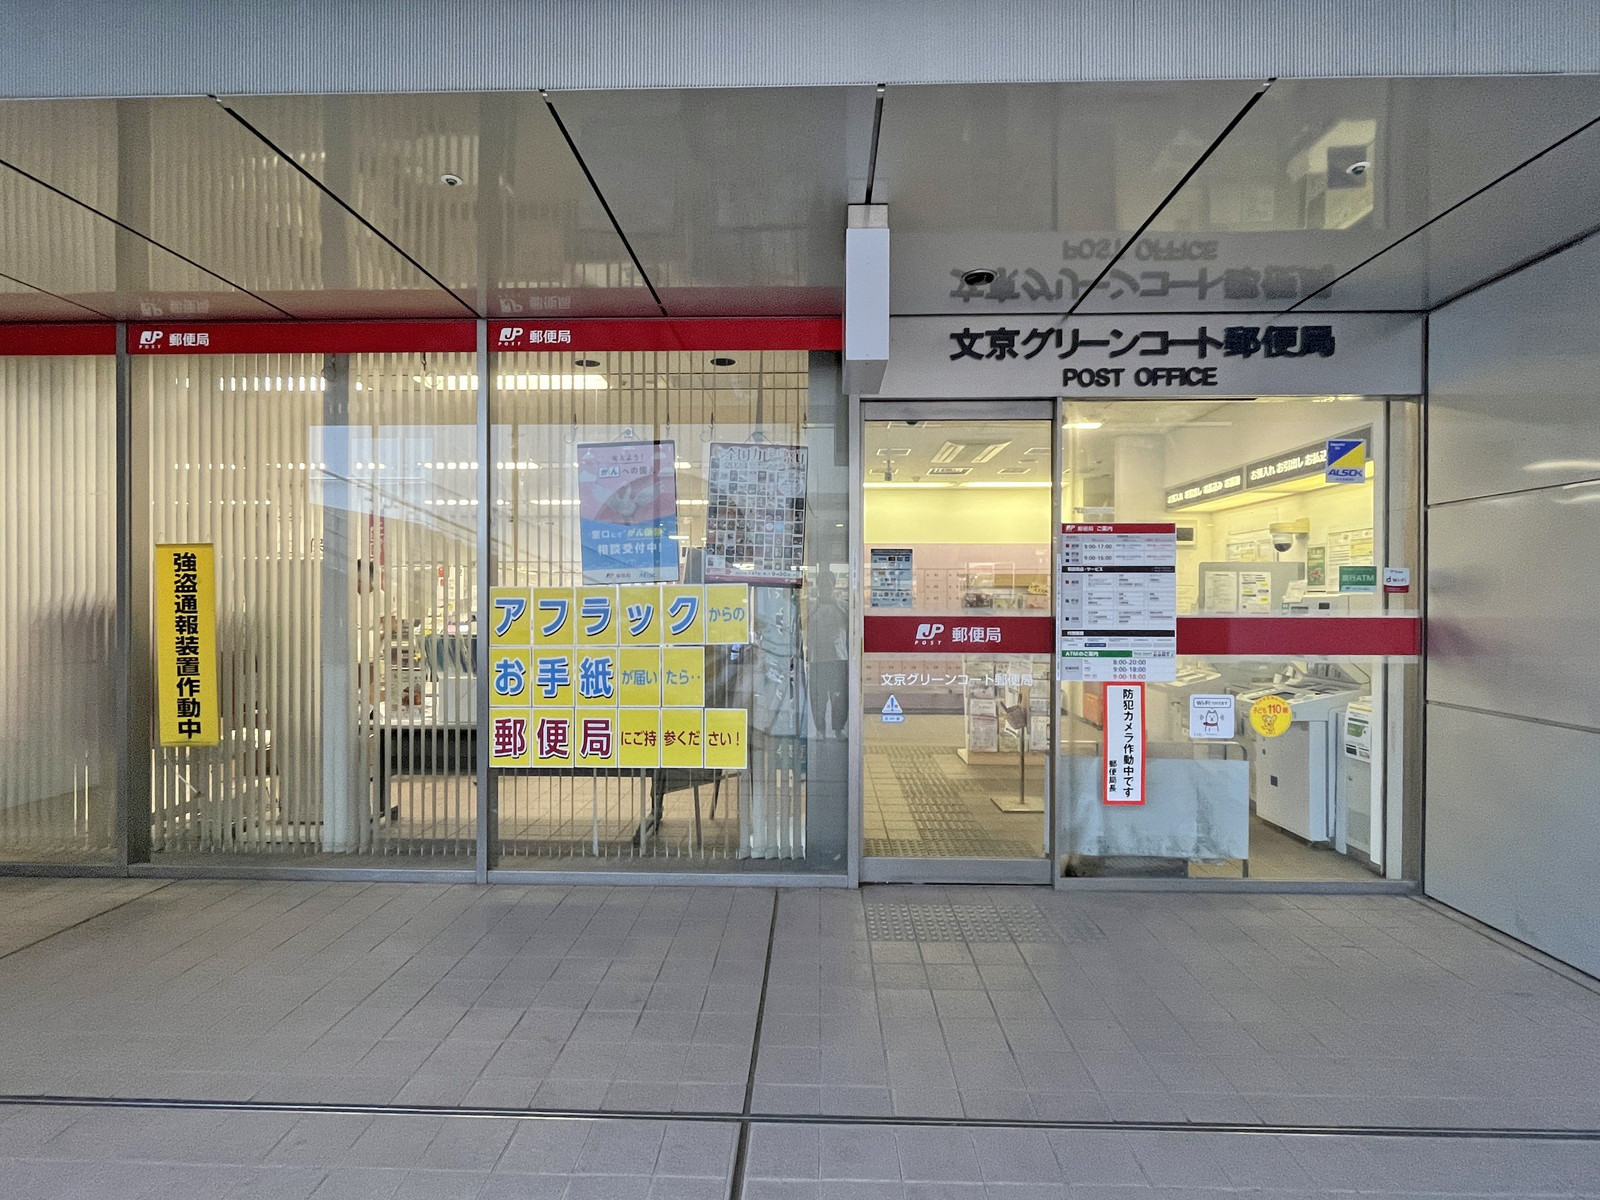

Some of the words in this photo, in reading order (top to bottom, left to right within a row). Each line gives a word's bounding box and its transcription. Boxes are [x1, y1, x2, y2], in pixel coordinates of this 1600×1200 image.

[169, 333, 209, 346] 郵便局
[530, 330, 571, 343] 郵便局
[949, 325, 1336, 361] 文京グリーンコート郵便局
[1063, 367, 1125, 387] POST
[1134, 367, 1218, 387] OFFICE
[1328, 469, 1363, 477] ALSOK
[952, 627, 1001, 643] 郵便局
[173, 552, 201, 739] 強盗通報装置作動中
[881, 673, 1033, 686] 文京グリーンコート郵便局
[1123, 689, 1134, 798] 防犯カメラ作動中です
